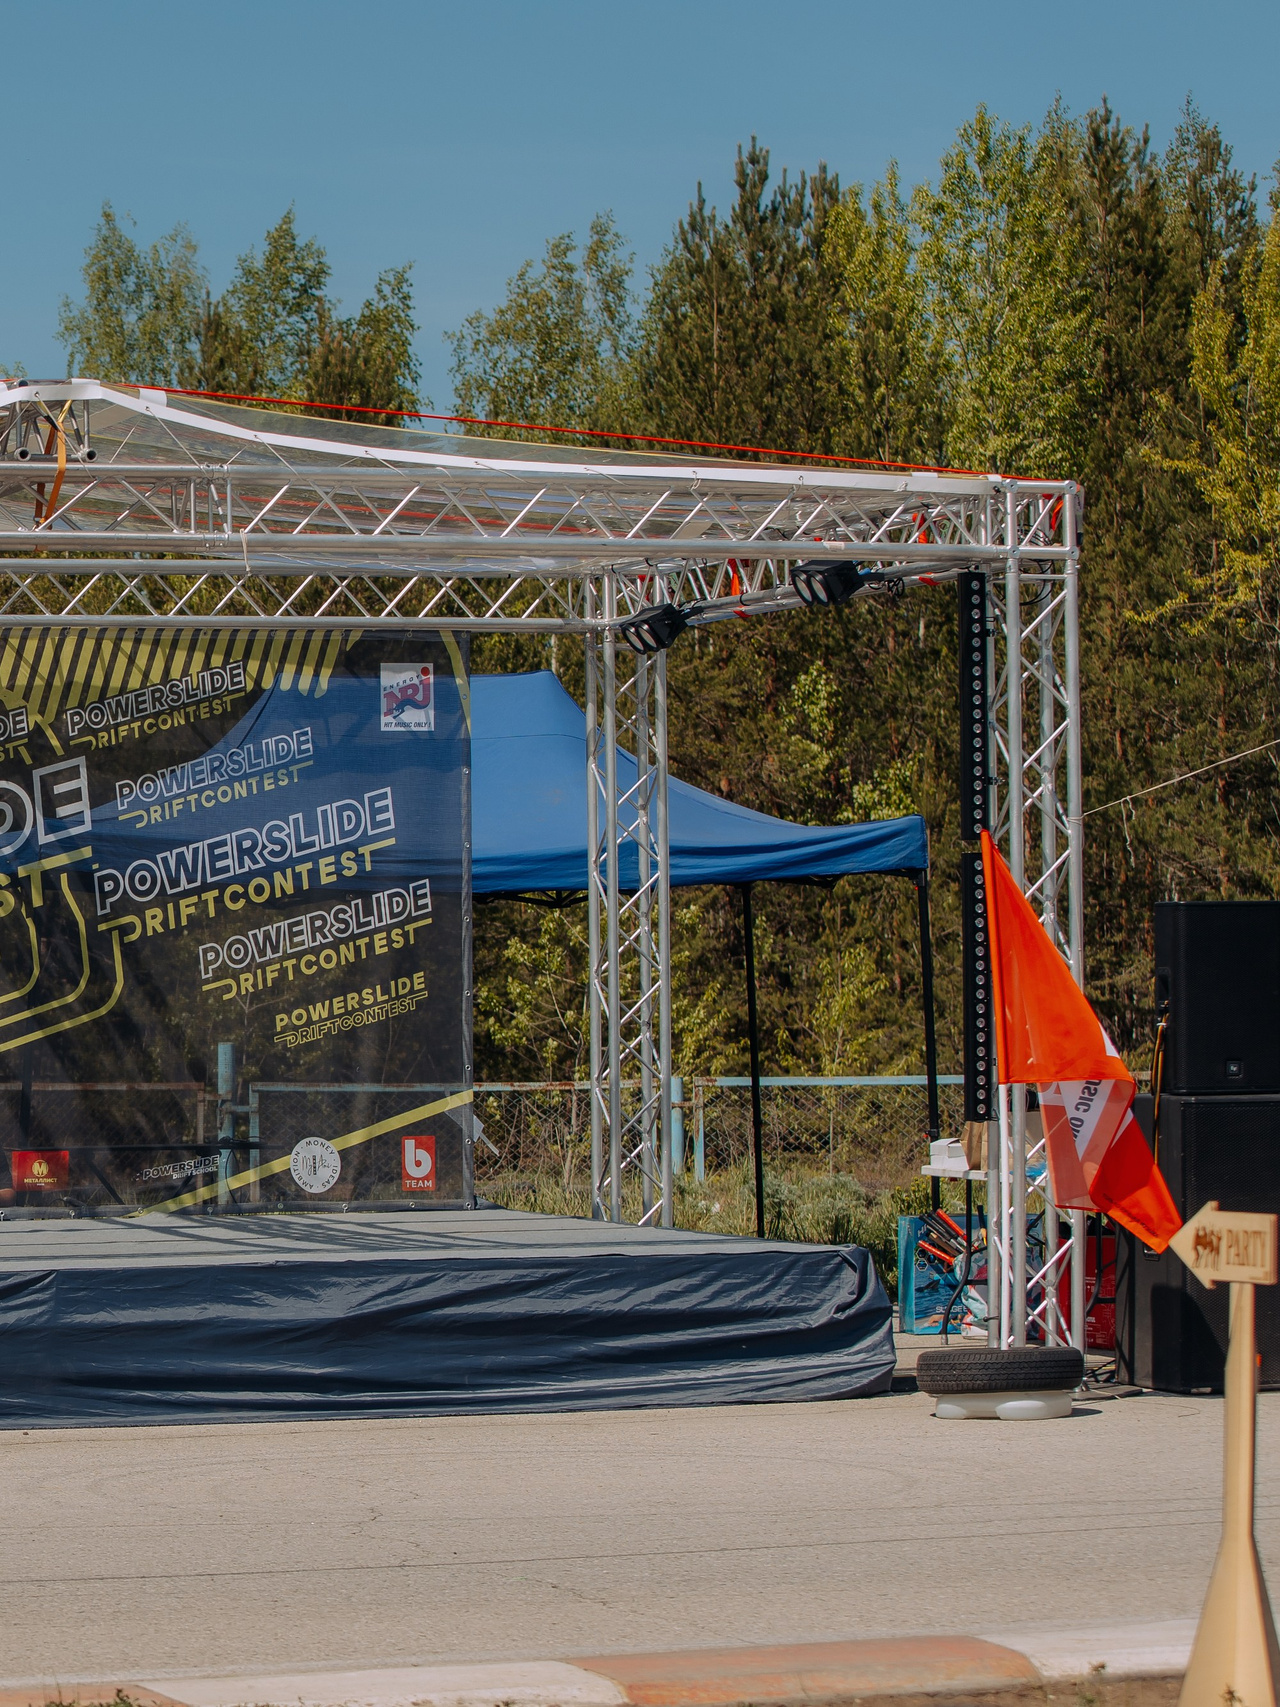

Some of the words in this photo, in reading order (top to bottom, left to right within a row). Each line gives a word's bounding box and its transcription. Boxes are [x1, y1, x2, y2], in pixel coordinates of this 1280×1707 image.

[67, 661, 246, 737] POWERSLIDE
[383, 674, 420, 691] ENERGY
[69, 692, 246, 750] DRIFTCONTEST
[116, 727, 313, 811] POWERSLIDE
[118, 760, 314, 828] DRIFTCONTEST
[94, 787, 395, 915] POWERSLIDE
[98, 837, 396, 944] DRIFTCONTEST
[199, 878, 432, 979] POWERSLIDE
[202, 918, 433, 1000] DRIFTCONTEST
[274, 971, 426, 1032] POWERSLIDE
[274, 992, 428, 1048] DRIFTCONTEST
[143, 1155, 220, 1180] POWERSLIDE
[172, 1172, 192, 1180] DRIFT
[192, 1166, 218, 1176] SCHOOL
[292, 1150, 314, 1189] AMBITION
[305, 1139, 335, 1155] MONEY
[321, 1165, 338, 1188] IDEAS
[404, 1180, 433, 1188] TEAM
